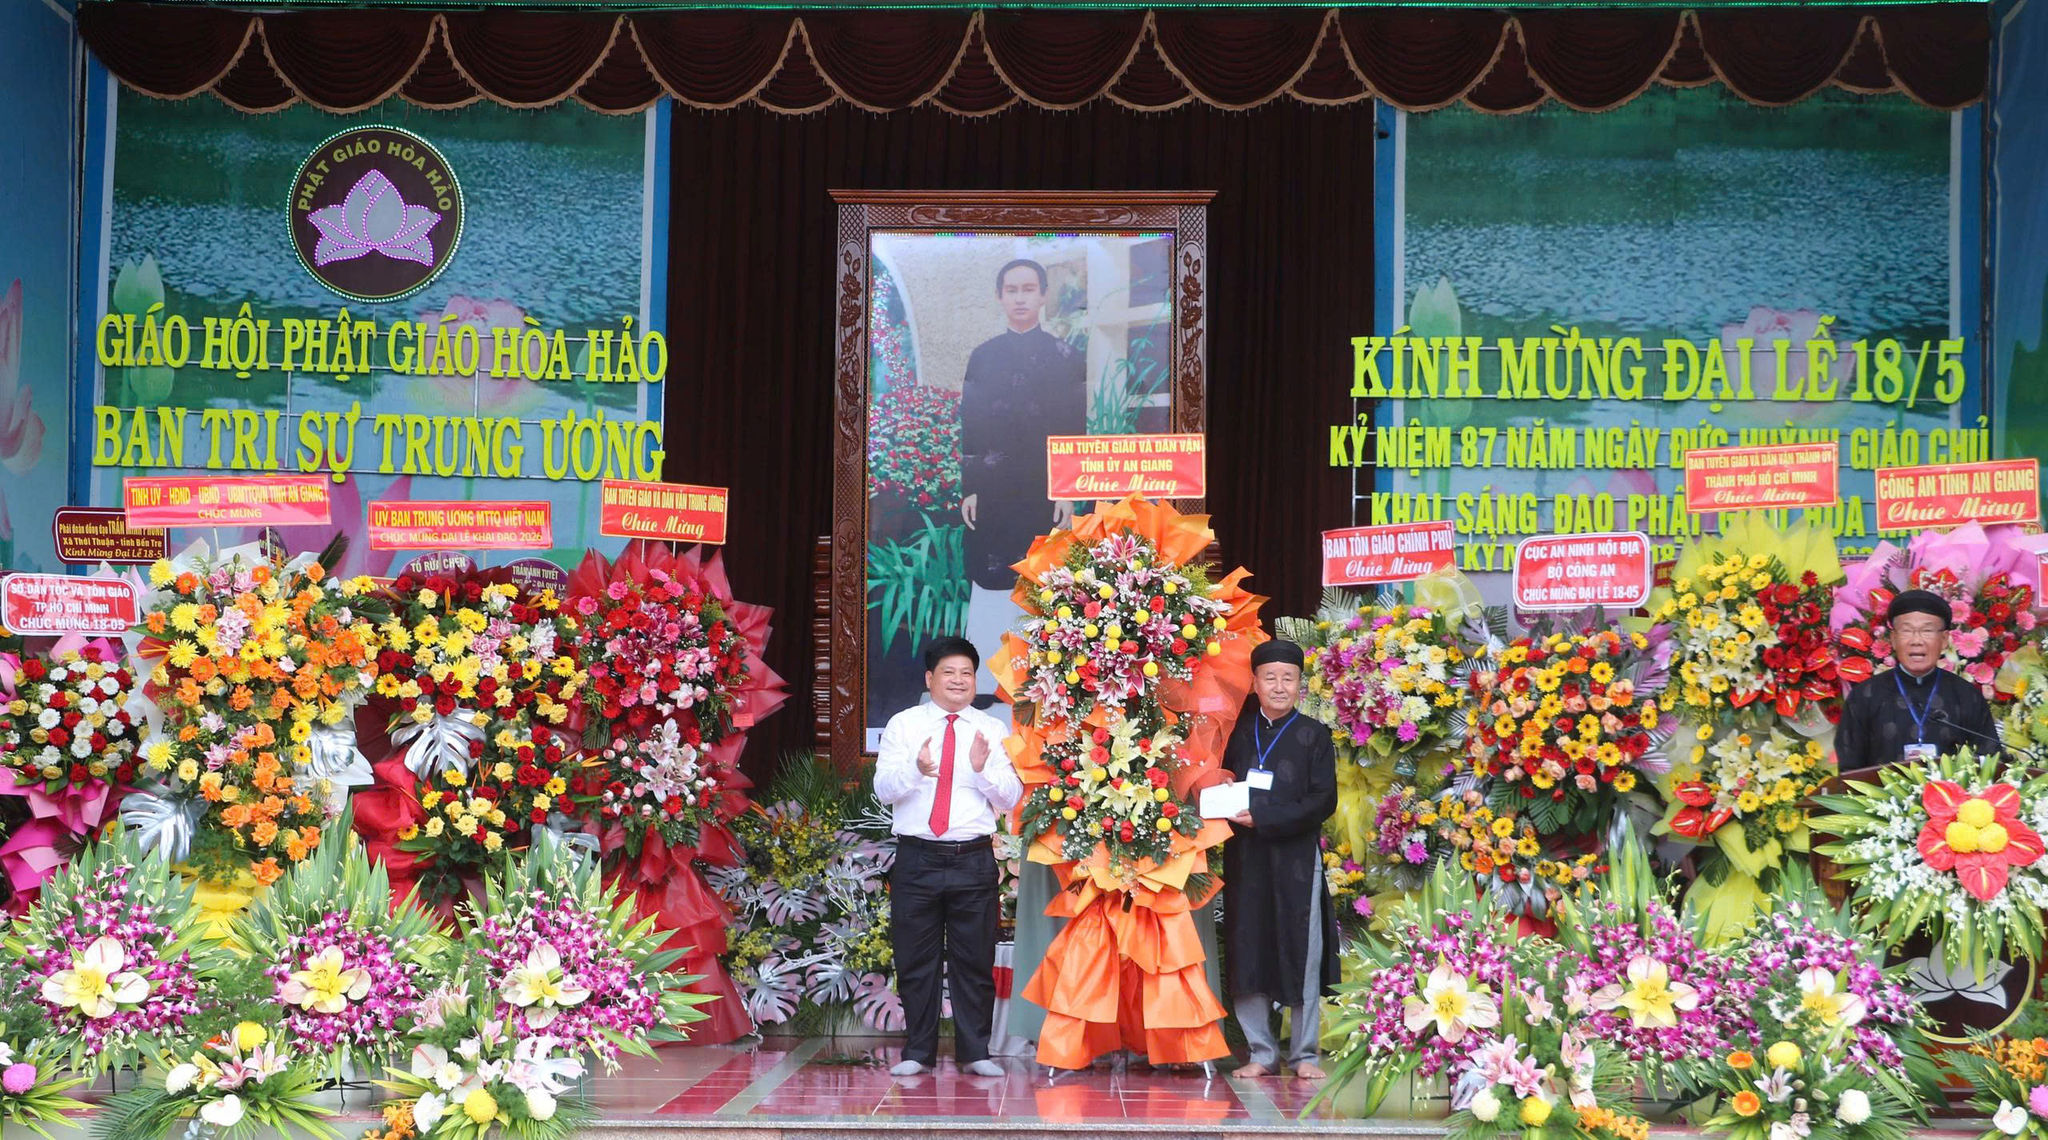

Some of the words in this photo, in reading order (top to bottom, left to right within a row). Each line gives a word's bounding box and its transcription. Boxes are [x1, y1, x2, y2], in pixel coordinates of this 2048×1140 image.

[298, 159, 330, 211] PHẬT
[332, 138, 381, 163] GIÁO
[387, 141, 427, 171] HÒA
[425, 168, 452, 211] HẢO
[97, 302, 190, 368] GIÁO
[200, 302, 270, 379] HỘI
[281, 306, 377, 382] PHẬT
[387, 314, 480, 376] GIÁO
[490, 316, 572, 381] HÒA
[585, 315, 668, 383] HẢO
[1351, 325, 1482, 399] KÍNH
[1497, 325, 1646, 400] MỪNG
[1662, 338, 1754, 413] ĐẠI
[1772, 314, 1838, 401] LỄ
[1851, 336, 1966, 409] 18/5
[93, 405, 187, 467] BAN
[296, 400, 361, 483] SỰ
[373, 414, 524, 478] TRUNG
[540, 409, 665, 482] ƯƠNG
[1052, 441, 1073, 454] BAN
[1076, 439, 1109, 454] TUYÊN
[1111, 438, 1136, 453] GIÁO
[1139, 438, 1152, 453] VÀ
[1155, 438, 1177, 453] DÂN
[1180, 438, 1200, 455] VẬN
[1330, 412, 1368, 467] KỶ
[1376, 417, 1451, 478] NIỆM
[1460, 426, 1497, 468] 87
[1506, 418, 1576, 469] NĂM
[1583, 419, 1660, 469] NGÀY
[1851, 419, 1919, 470] GIÁO
[1928, 414, 1990, 464] CHỦ
[1123, 460, 1138, 471] AN
[1141, 459, 1173, 471] GIANG
[1075, 474, 1119, 492] Chúc
[1123, 474, 1177, 495] Mừng
[1705, 473, 1735, 488] THÀNH
[1792, 471, 1818, 484] MINH
[1879, 474, 1915, 499] CÔNG
[1918, 475, 1936, 497] AN
[1972, 471, 1991, 494] AN
[1994, 469, 2035, 493] GIANG
[1714, 490, 1754, 504] Chúc
[391, 510, 410, 527] BAN
[413, 510, 444, 526] TRUNG
[476, 510, 500, 527] MTTQ
[524, 510, 545, 526] NAM
[1371, 492, 1441, 526] KHAI
[1456, 483, 1537, 534] SÁNG
[1888, 500, 1946, 523] Chúc
[1952, 497, 2026, 519] Mừng
[622, 511, 658, 532] Chúc
[661, 515, 705, 539] Mừng
[65, 548, 86, 556] Kính
[115, 548, 130, 558] Đại
[144, 550, 162, 558] 18-5
[151, 539, 162, 548] Tre
[1326, 538, 1347, 558] BAN
[1349, 532, 1369, 556] TÔN
[1371, 531, 1395, 555] GIÁO
[1397, 528, 1429, 553] CHÍNH
[1525, 546, 1547, 561] CỤC
[1551, 545, 1565, 558] AN
[1568, 543, 1594, 557] NINH
[1598, 539, 1617, 560] NỘI
[1620, 541, 1640, 557] ĐỊA
[1345, 559, 1383, 577] Chúc
[1386, 557, 1433, 575] Mừng
[1547, 564, 1562, 581] BỘ
[1566, 562, 1597, 578] CÔNG
[1600, 564, 1616, 577] AN
[107, 585, 130, 598] GIÁO
[1523, 585, 1547, 601] CHÚC
[1578, 586, 1594, 602] ĐẠI
[1613, 585, 1639, 599] 18-05
[85, 603, 110, 614] MINH
[93, 618, 126, 631] 18-05
